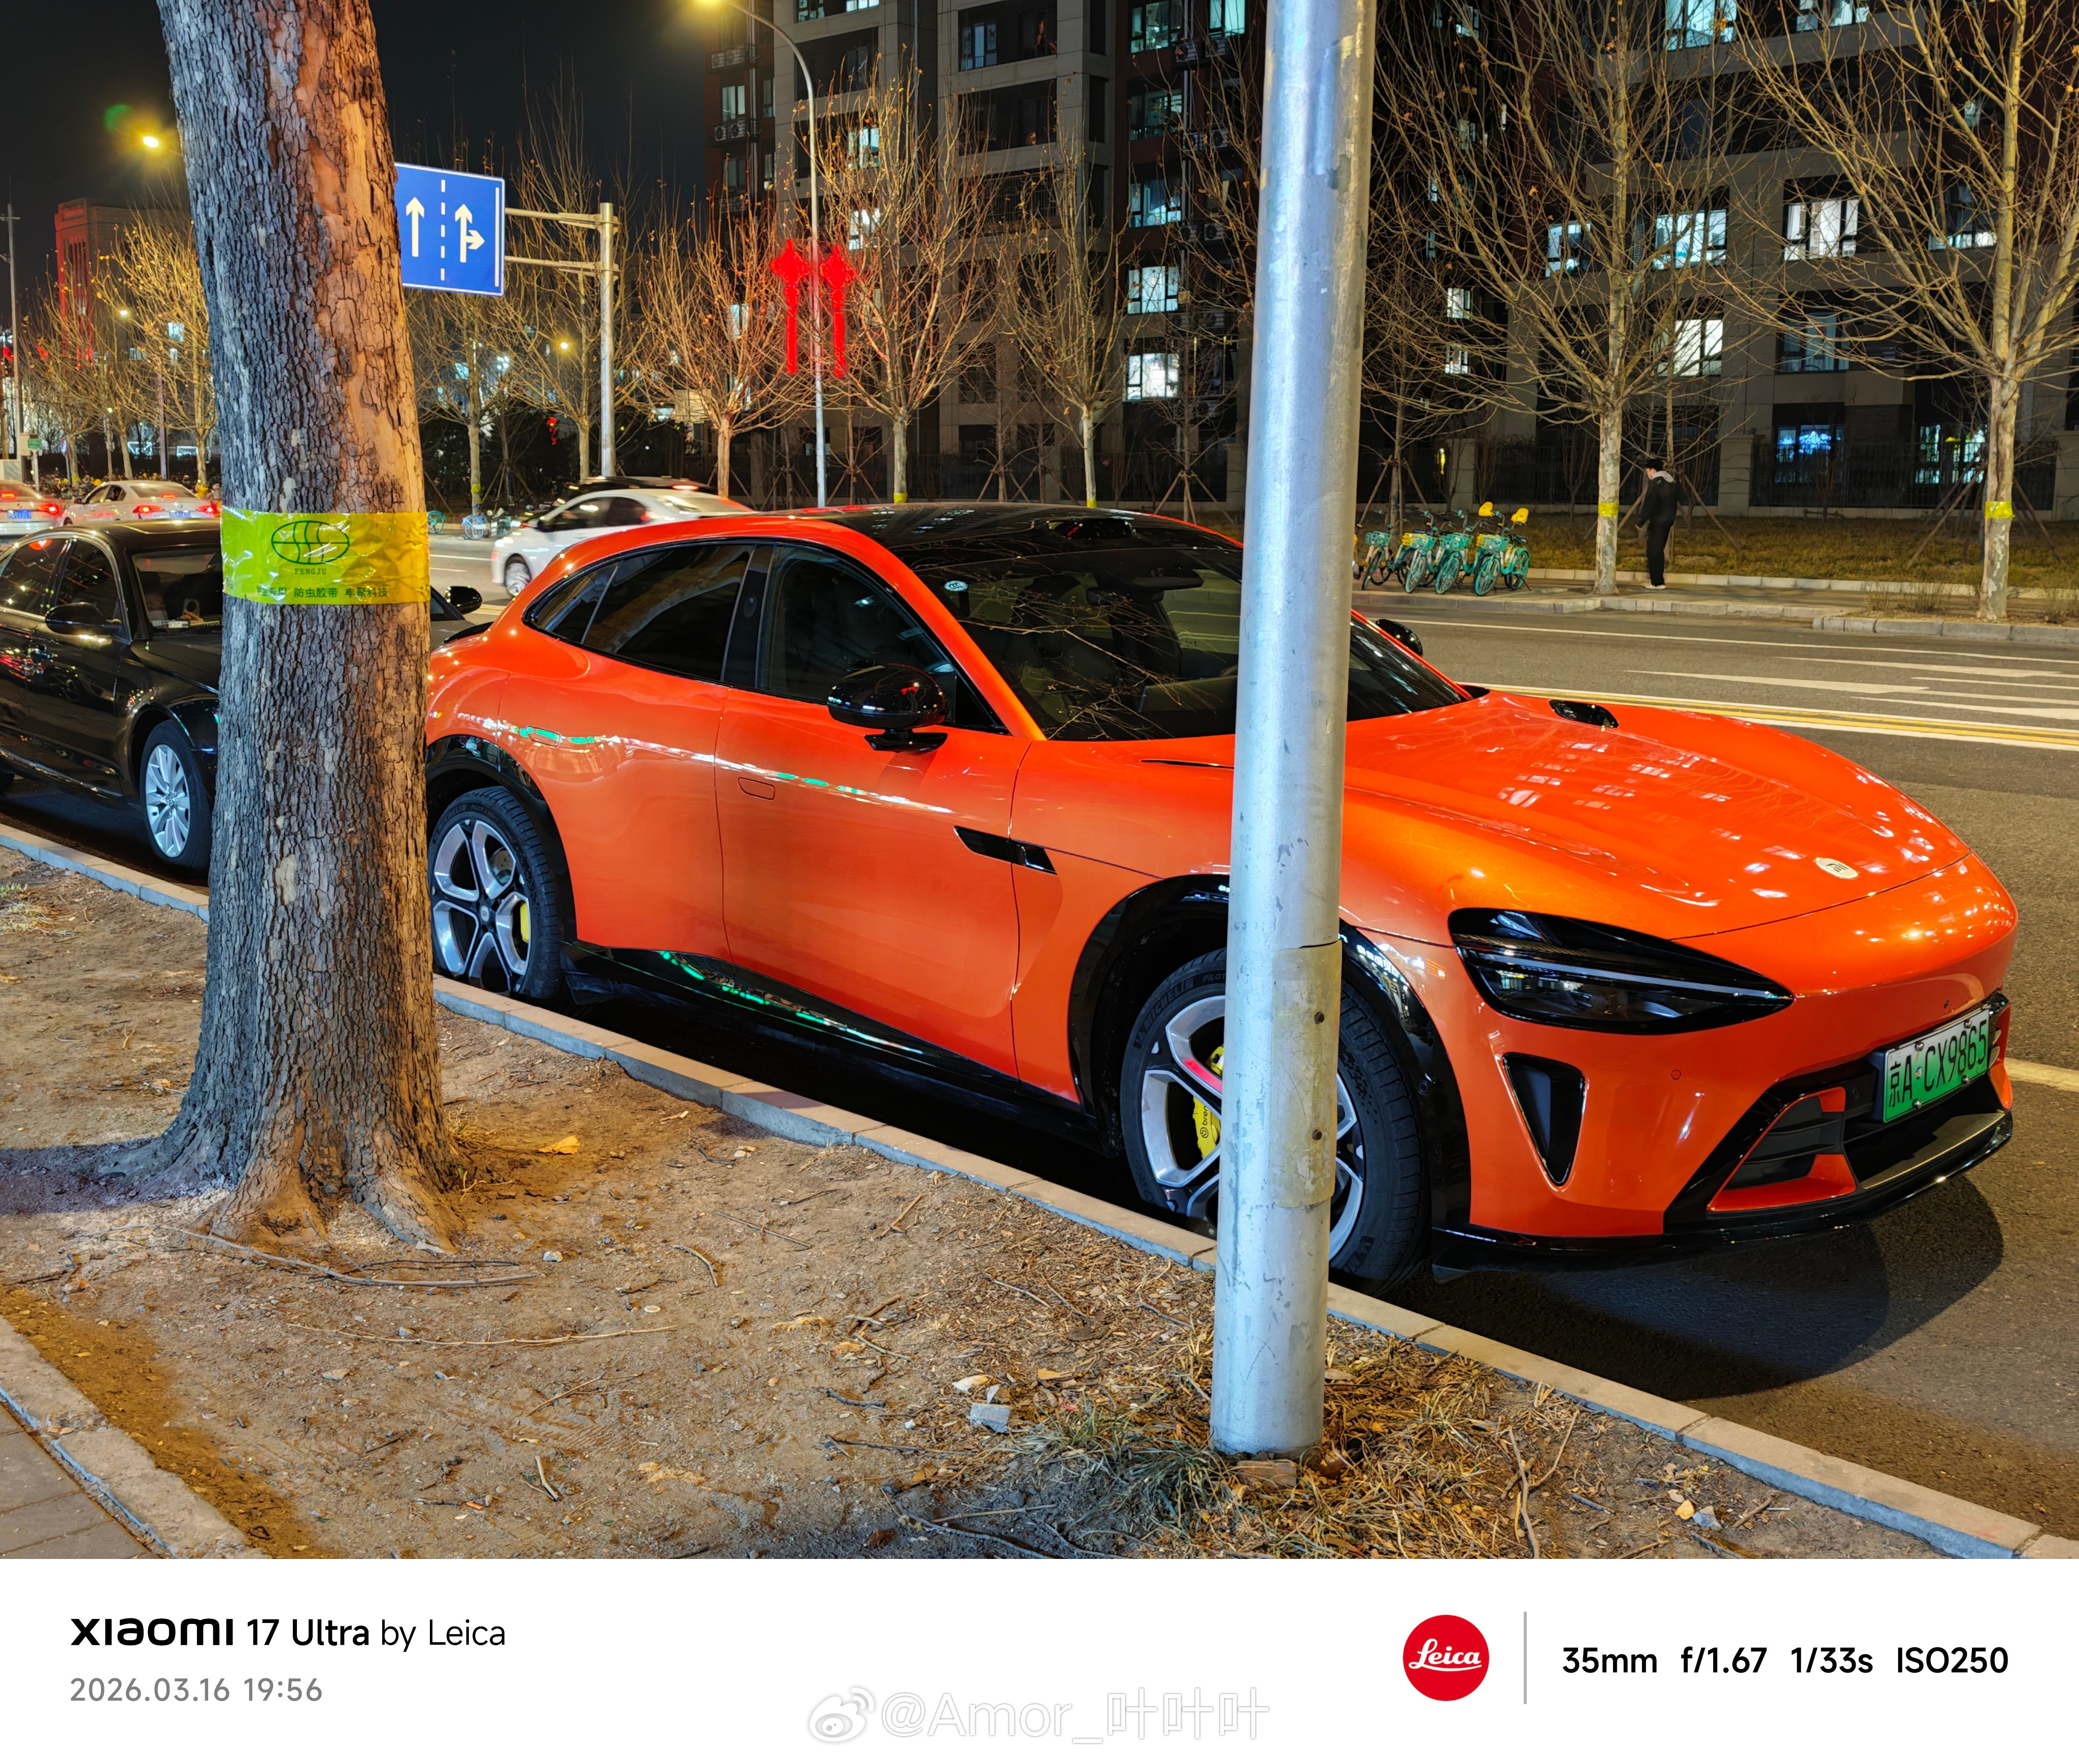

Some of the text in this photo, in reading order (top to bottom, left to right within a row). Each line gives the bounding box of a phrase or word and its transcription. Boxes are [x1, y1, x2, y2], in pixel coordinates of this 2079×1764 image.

[293, 587, 339, 598] 防虫胶带
[1144, 978, 1194, 1031] MICHELIN
